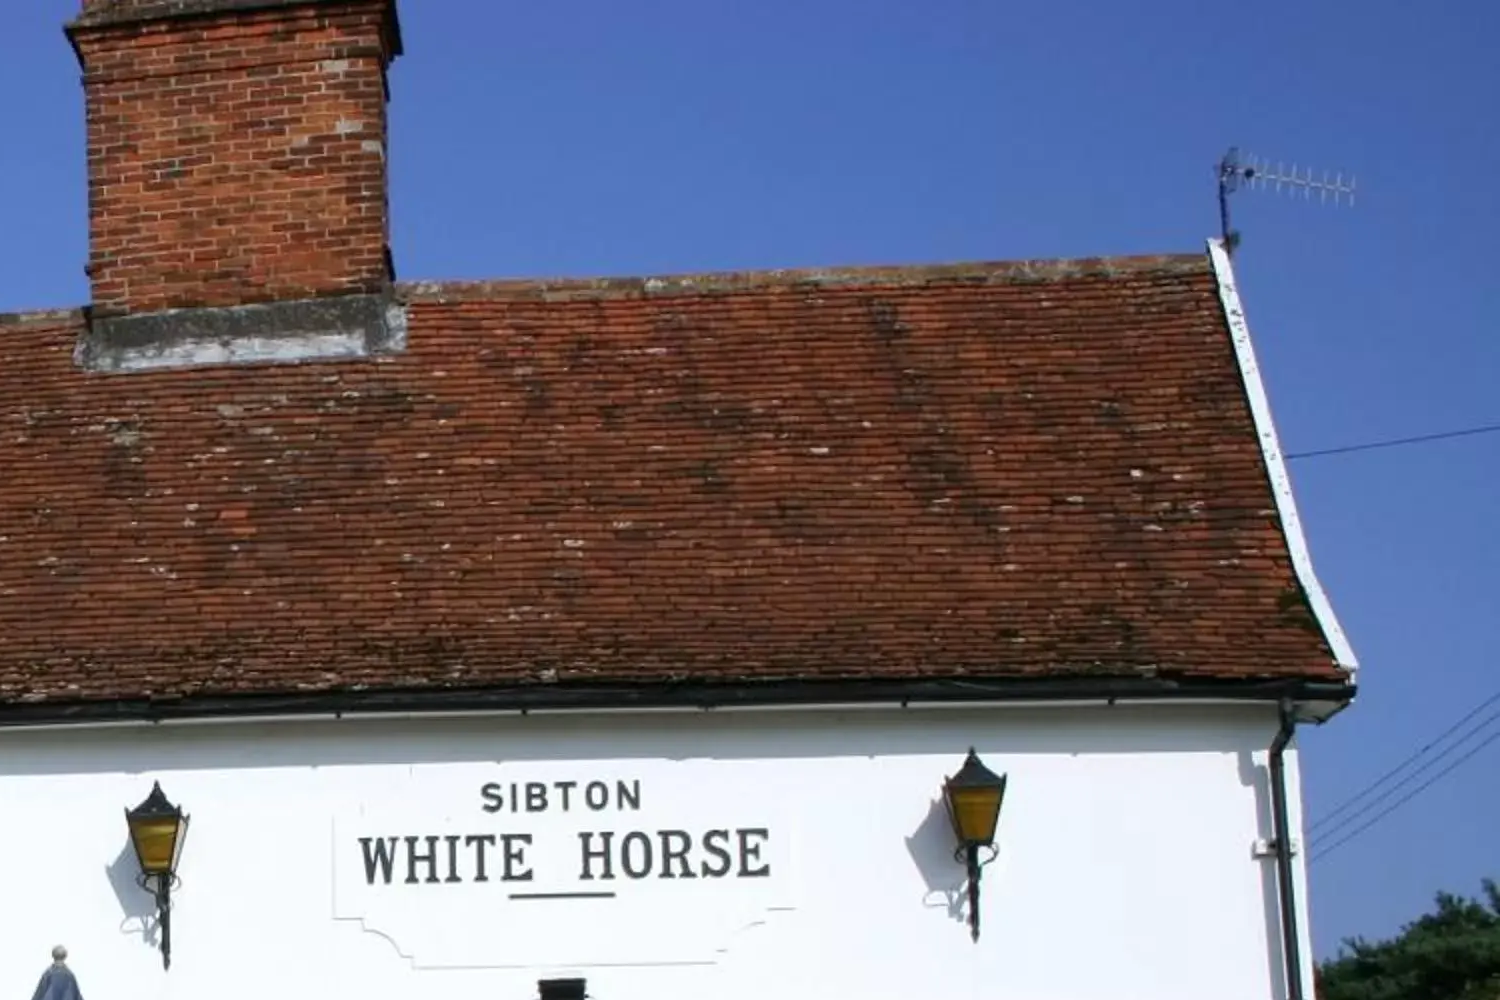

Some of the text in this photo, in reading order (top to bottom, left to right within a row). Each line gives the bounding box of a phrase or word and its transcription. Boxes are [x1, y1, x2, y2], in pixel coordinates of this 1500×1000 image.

[481, 780, 641, 813] SIBTON
[358, 828, 770, 885] WHITE HORSE
